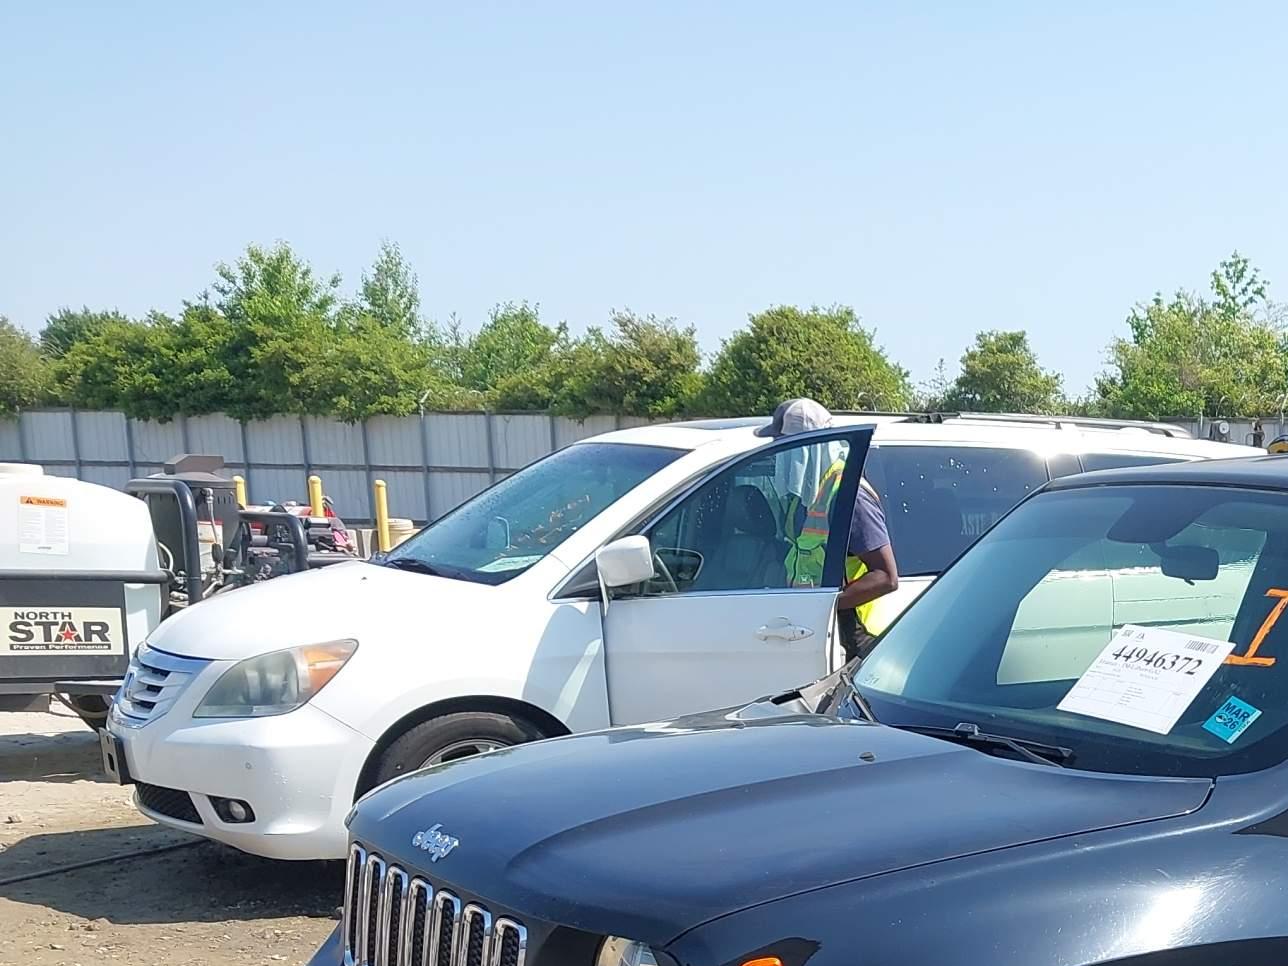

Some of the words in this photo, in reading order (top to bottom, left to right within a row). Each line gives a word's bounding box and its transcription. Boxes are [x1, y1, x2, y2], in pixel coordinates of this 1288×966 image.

[14, 611, 72, 620] NORTH
[8, 621, 110, 642] STAR
[1112, 644, 1203, 676] 44946372
[1222, 702, 1250, 723] MAR
[1223, 717, 1240, 730] 26
[412, 823, 459, 863] Jeep
